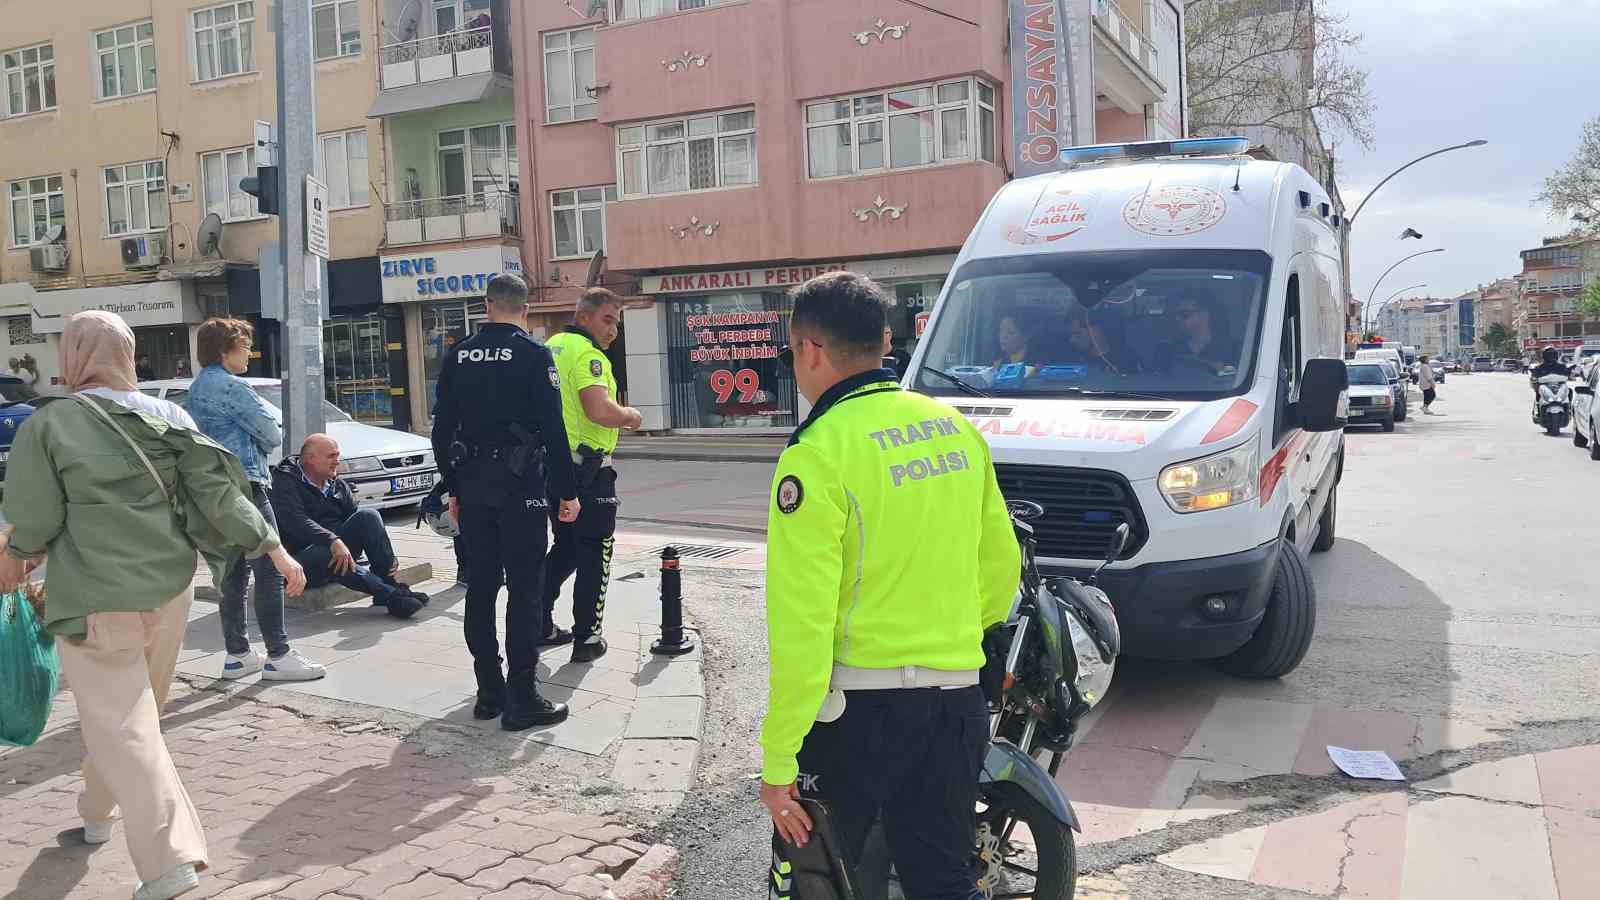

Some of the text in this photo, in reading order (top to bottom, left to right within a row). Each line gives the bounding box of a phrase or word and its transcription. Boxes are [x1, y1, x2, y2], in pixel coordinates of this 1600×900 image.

[712, 310, 780, 326] KAMPANYA
[695, 328, 771, 344] TÜL PERDEDE
[690, 345, 730, 362] BÜYÜK
[710, 368, 759, 403] 99
[525, 498, 548, 508] POL
